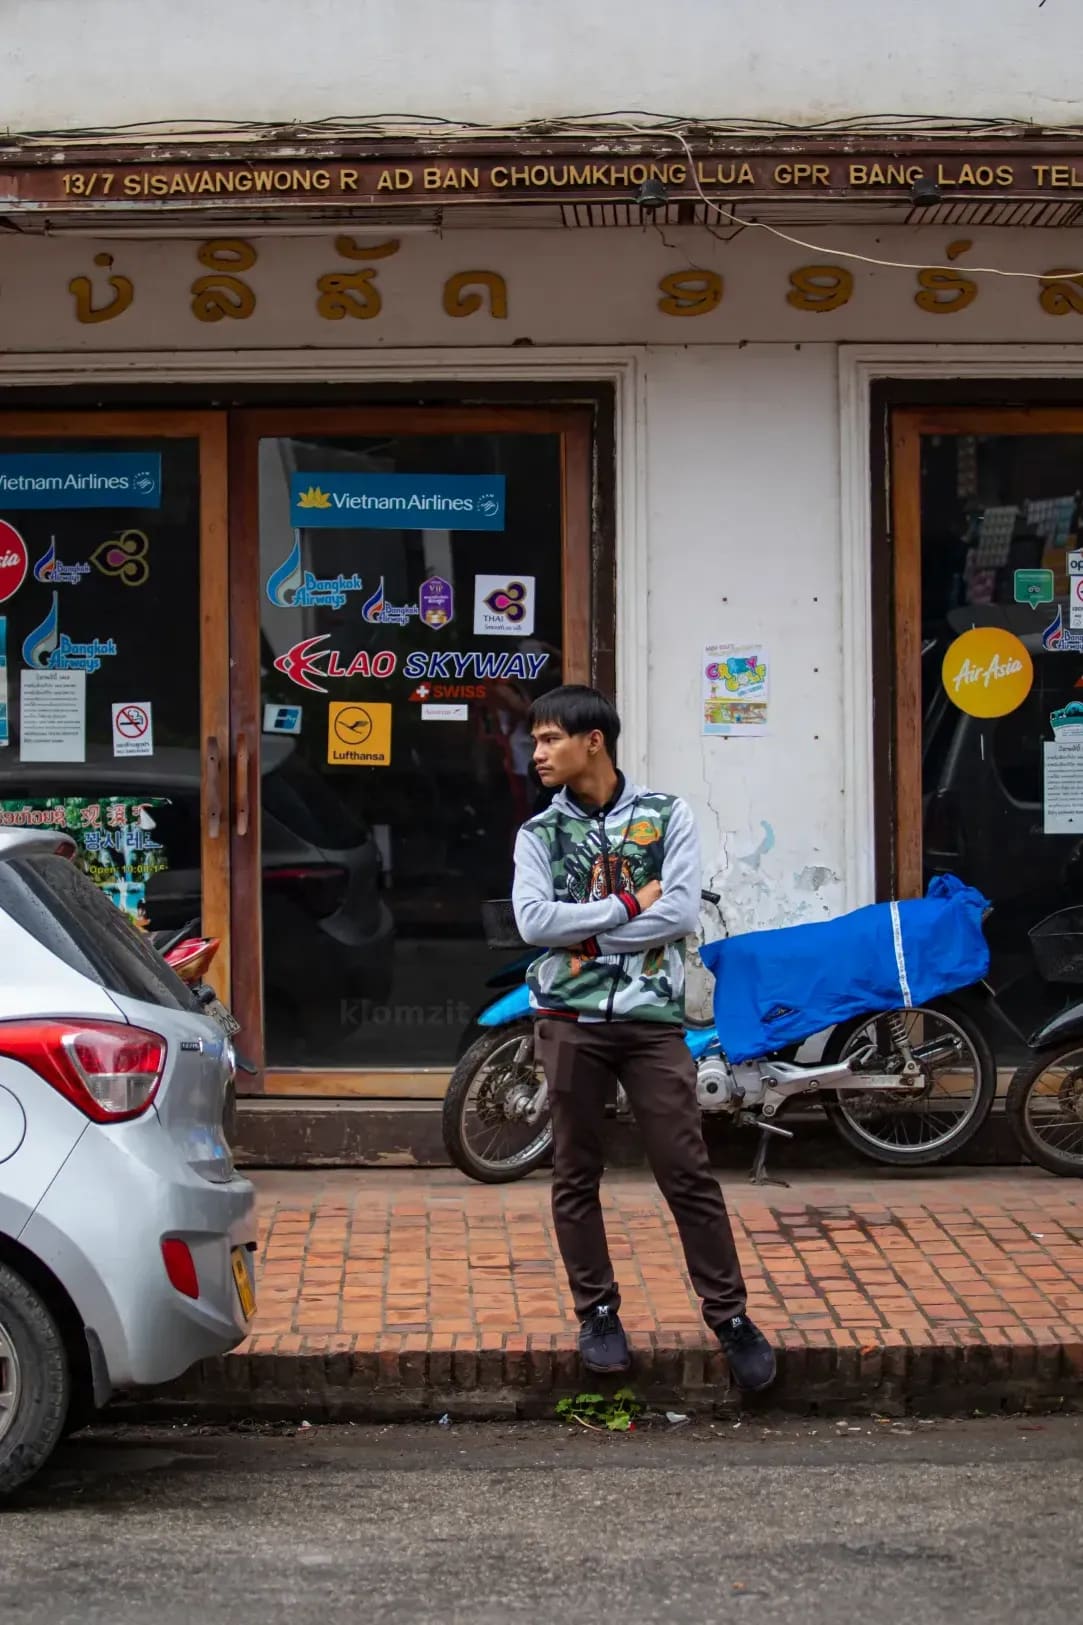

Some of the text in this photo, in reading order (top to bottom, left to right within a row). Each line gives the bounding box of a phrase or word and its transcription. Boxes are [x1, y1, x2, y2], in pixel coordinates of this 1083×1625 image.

[62, 173, 115, 197] 13/7
[123, 169, 331, 196] SISAVANGWONG
[423, 167, 480, 189] BAN
[490, 163, 687, 186] CHOUMKHONG
[698, 163, 755, 185] LUA
[774, 164, 830, 186] GPR
[849, 164, 924, 186] BANG
[937, 164, 1014, 187] LAOS
[0, 475, 63, 490] ietnam
[64, 473, 129, 489] Airlines
[332, 493, 406, 509] Vietnam
[407, 494, 473, 511] Airlines
[304, 570, 362, 593] Bangkok
[293, 584, 347, 610] Airways
[60, 633, 117, 657] Bangkok
[48, 649, 101, 673] Airways
[327, 650, 550, 680] LAO SKYWAY
[432, 684, 487, 699] SWISS
[332, 750, 385, 761] Lufthansa
